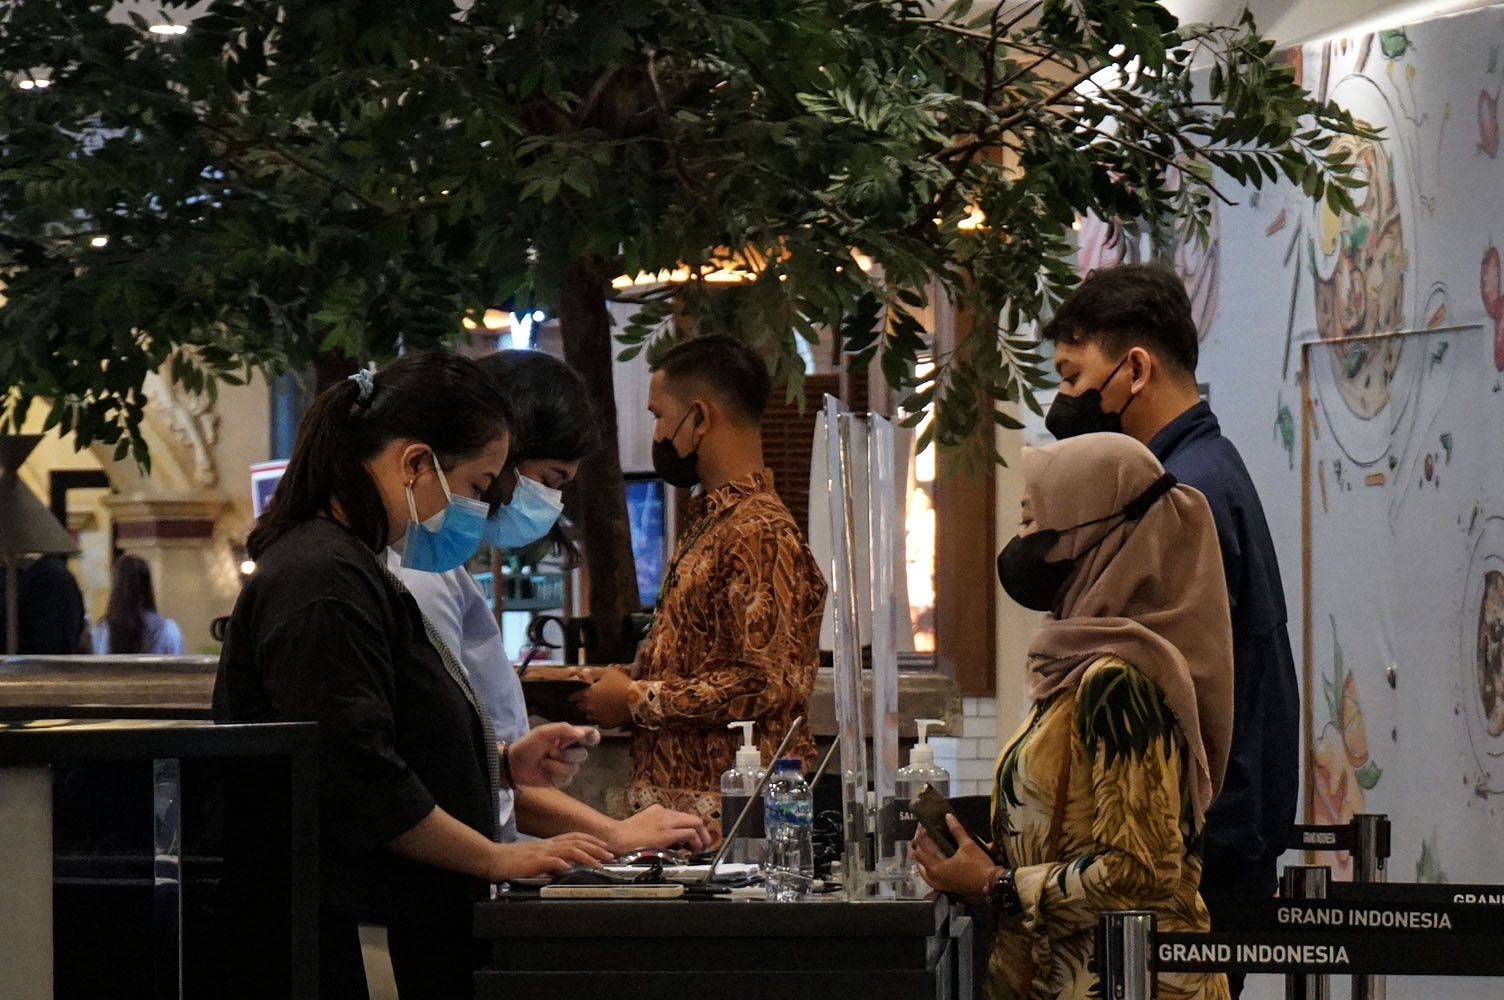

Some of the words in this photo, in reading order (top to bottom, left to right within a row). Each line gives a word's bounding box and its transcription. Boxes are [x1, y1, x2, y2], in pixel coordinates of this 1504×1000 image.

[1278, 907, 1344, 925] GRAND
[1349, 910, 1452, 929] INDONESIA
[1158, 943, 1231, 962] GRAND
[1237, 944, 1350, 963] INDONESIA
